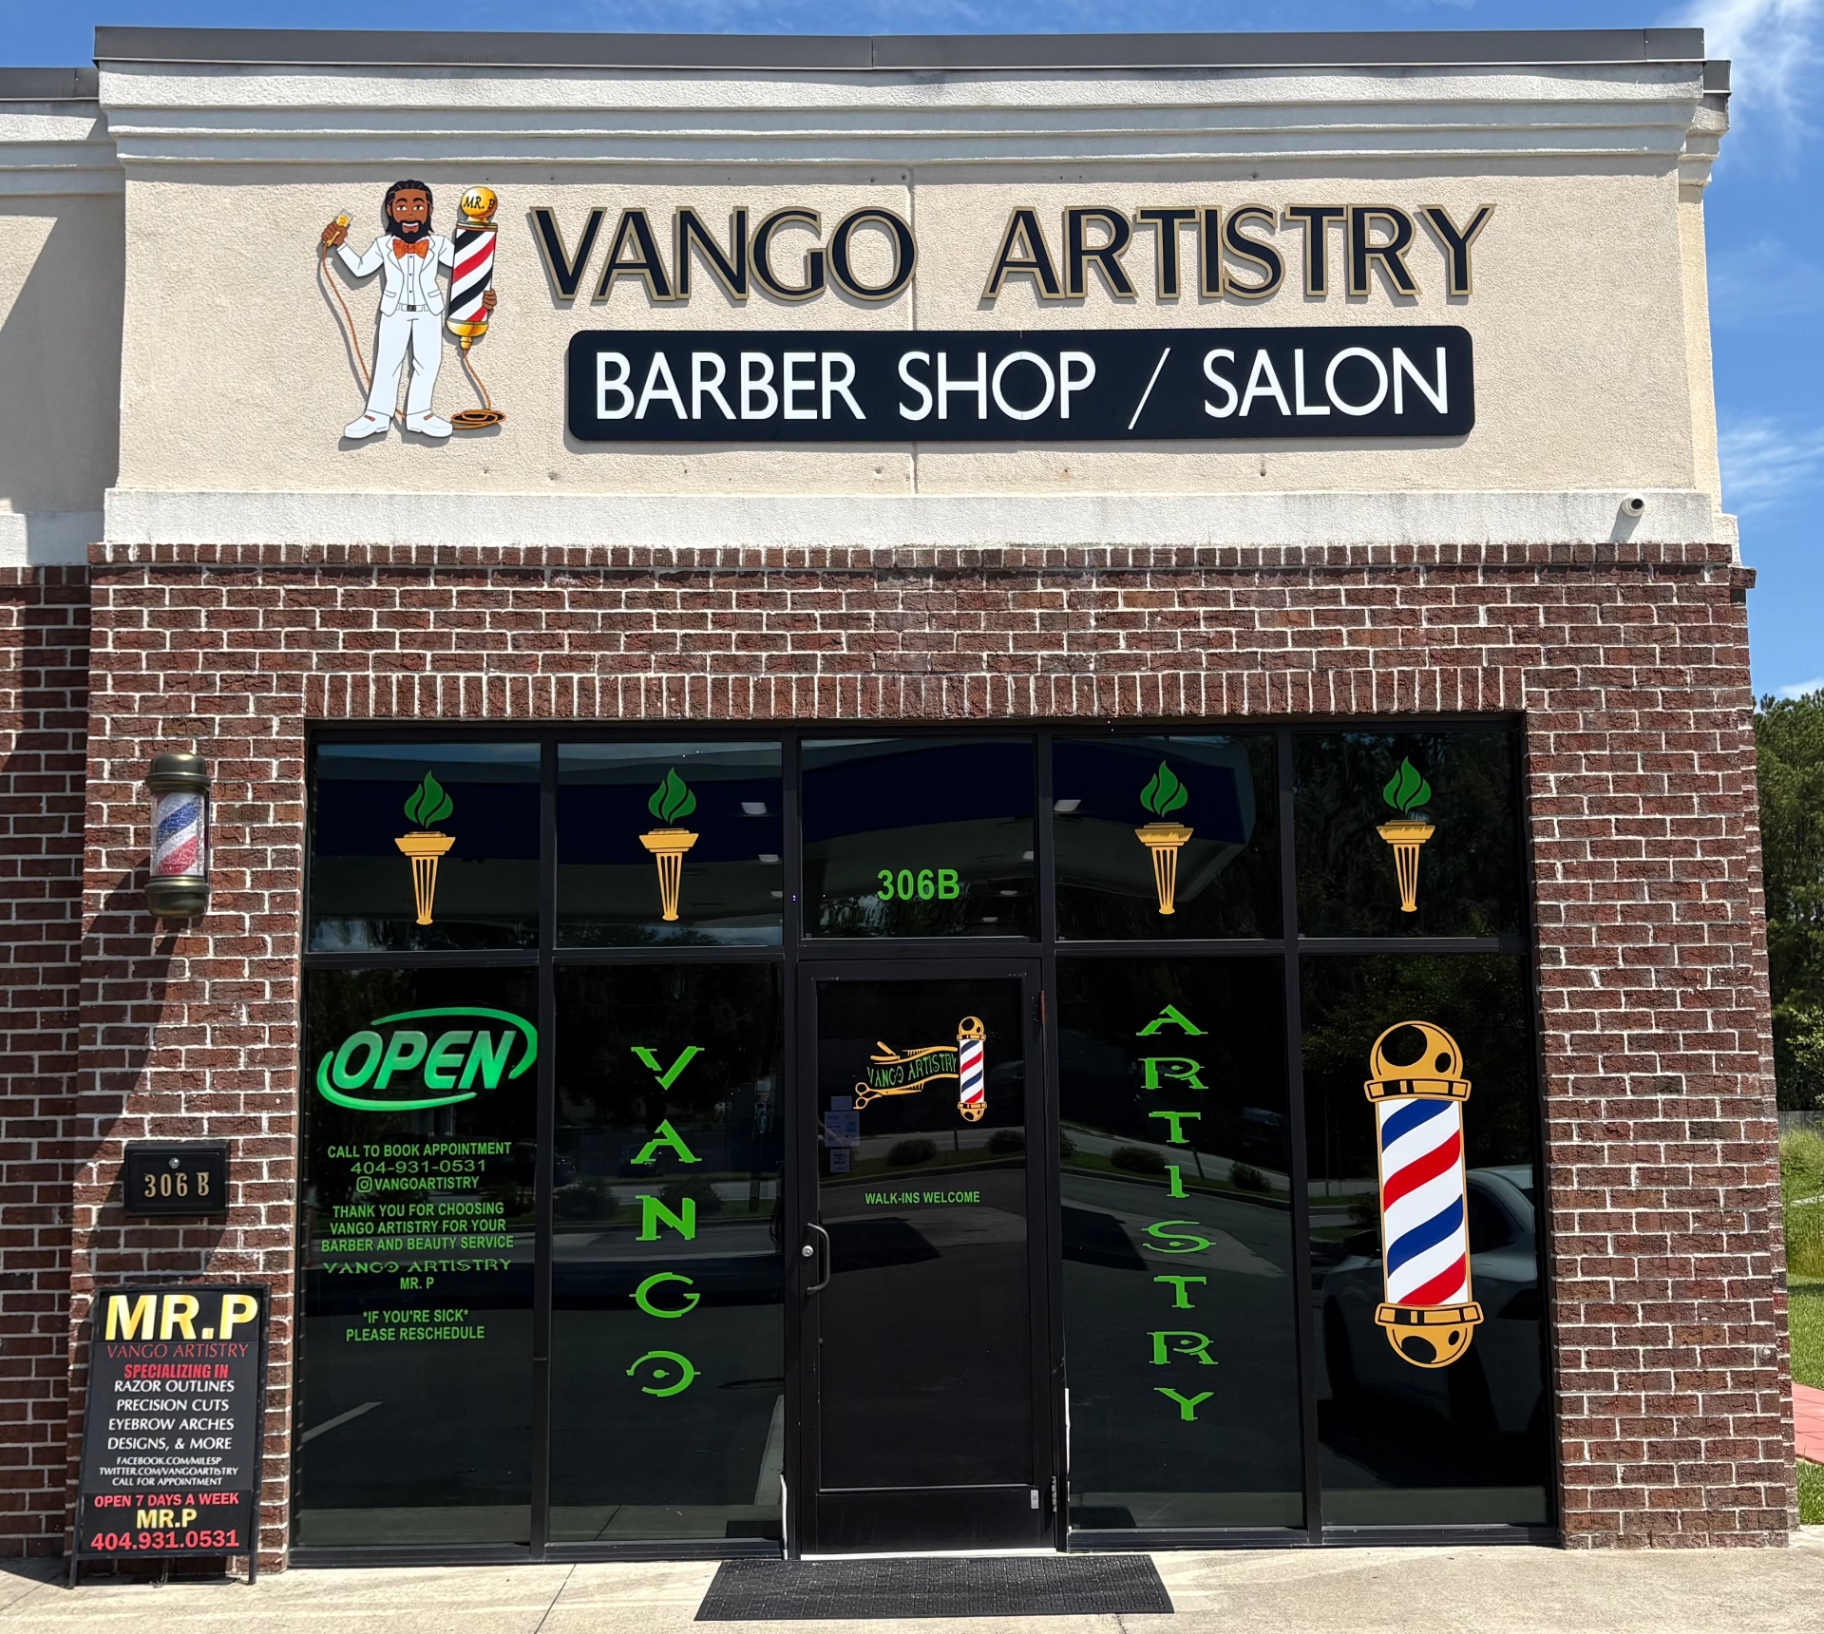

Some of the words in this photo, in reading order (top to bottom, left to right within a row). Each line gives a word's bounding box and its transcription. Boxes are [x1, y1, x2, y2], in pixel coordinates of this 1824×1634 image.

[463, 196, 485, 209] MR.
[530, 206, 918, 301] VANGO
[982, 203, 1497, 299] ARTISTRY
[595, 351, 867, 421] BARBER
[897, 350, 1096, 422] SHOP
[1127, 347, 1171, 431] /
[1203, 346, 1448, 419] SALON
[877, 869, 960, 901] 306B
[332, 1030, 517, 1090] OPEN
[866, 1066, 905, 1088] VANGO
[907, 1053, 957, 1081] ARTISTRY
[327, 1145, 360, 1158] CALL
[363, 1144, 380, 1158] TO
[384, 1143, 420, 1157] BOOK
[423, 1141, 512, 1156] APPOINTMENT
[350, 1159, 486, 1174] 404-931-0531
[374, 1176, 480, 1191] VANGOARTISTRY
[865, 1192, 920, 1205] WALK-INS
[923, 1191, 981, 1204] WELCOME
[332, 1205, 376, 1218] THANK
[379, 1204, 405, 1217] YOU
[409, 1204, 435, 1216] FOR
[438, 1202, 504, 1216] CHOOSING
[1135, 1004, 1218, 1421] ARTISTRY
[330, 1222, 374, 1235] VANGO
[377, 1220, 439, 1234] ARTISTRY
[442, 1219, 468, 1233] FOR
[471, 1218, 506, 1232] YOUR
[626, 1045, 705, 1398] VANGO
[321, 1239, 374, 1253] BARBER
[376, 1238, 403, 1251] AND
[407, 1236, 457, 1250] BEAUTY
[460, 1235, 514, 1249] SERVICE
[322, 1261, 400, 1275] VANGO
[407, 1258, 512, 1273] ARTISTRY
[400, 1277, 422, 1290] MR.
[426, 1277, 434, 1289] P
[104, 1294, 259, 1341] MR.P
[382, 1310, 430, 1323] YOU'RE
[345, 1328, 396, 1342] PLEASE
[399, 1325, 485, 1340] RESCHEDULE
[107, 1345, 169, 1359] VANGO
[173, 1343, 248, 1359] ARTISTRY
[124, 1364, 212, 1379] SPECIALIZING
[214, 1364, 229, 1378] IN
[114, 1380, 162, 1393] RAZOR
[165, 1380, 235, 1392] OUTLINES
[116, 1399, 188, 1412] PRECISION
[191, 1399, 230, 1411] CUTS
[108, 1418, 176, 1431] EYEBROW
[178, 1418, 234, 1431] ARCHES
[107, 1437, 170, 1451] DESIGNS,
[174, 1438, 186, 1450] &
[189, 1437, 233, 1450] MORE
[112, 1477, 135, 1486] CALL
[136, 1477, 156, 1486] FOR
[157, 1477, 223, 1486] APPOINTMENT
[94, 1495, 132, 1508] OPEN
[135, 1495, 144, 1507] 7
[149, 1494, 182, 1507] DAYS
[184, 1494, 196, 1506] A
[198, 1492, 239, 1505] WEEK
[136, 1508, 198, 1529] MR.P
[90, 1529, 240, 1551] 404.931.0531
